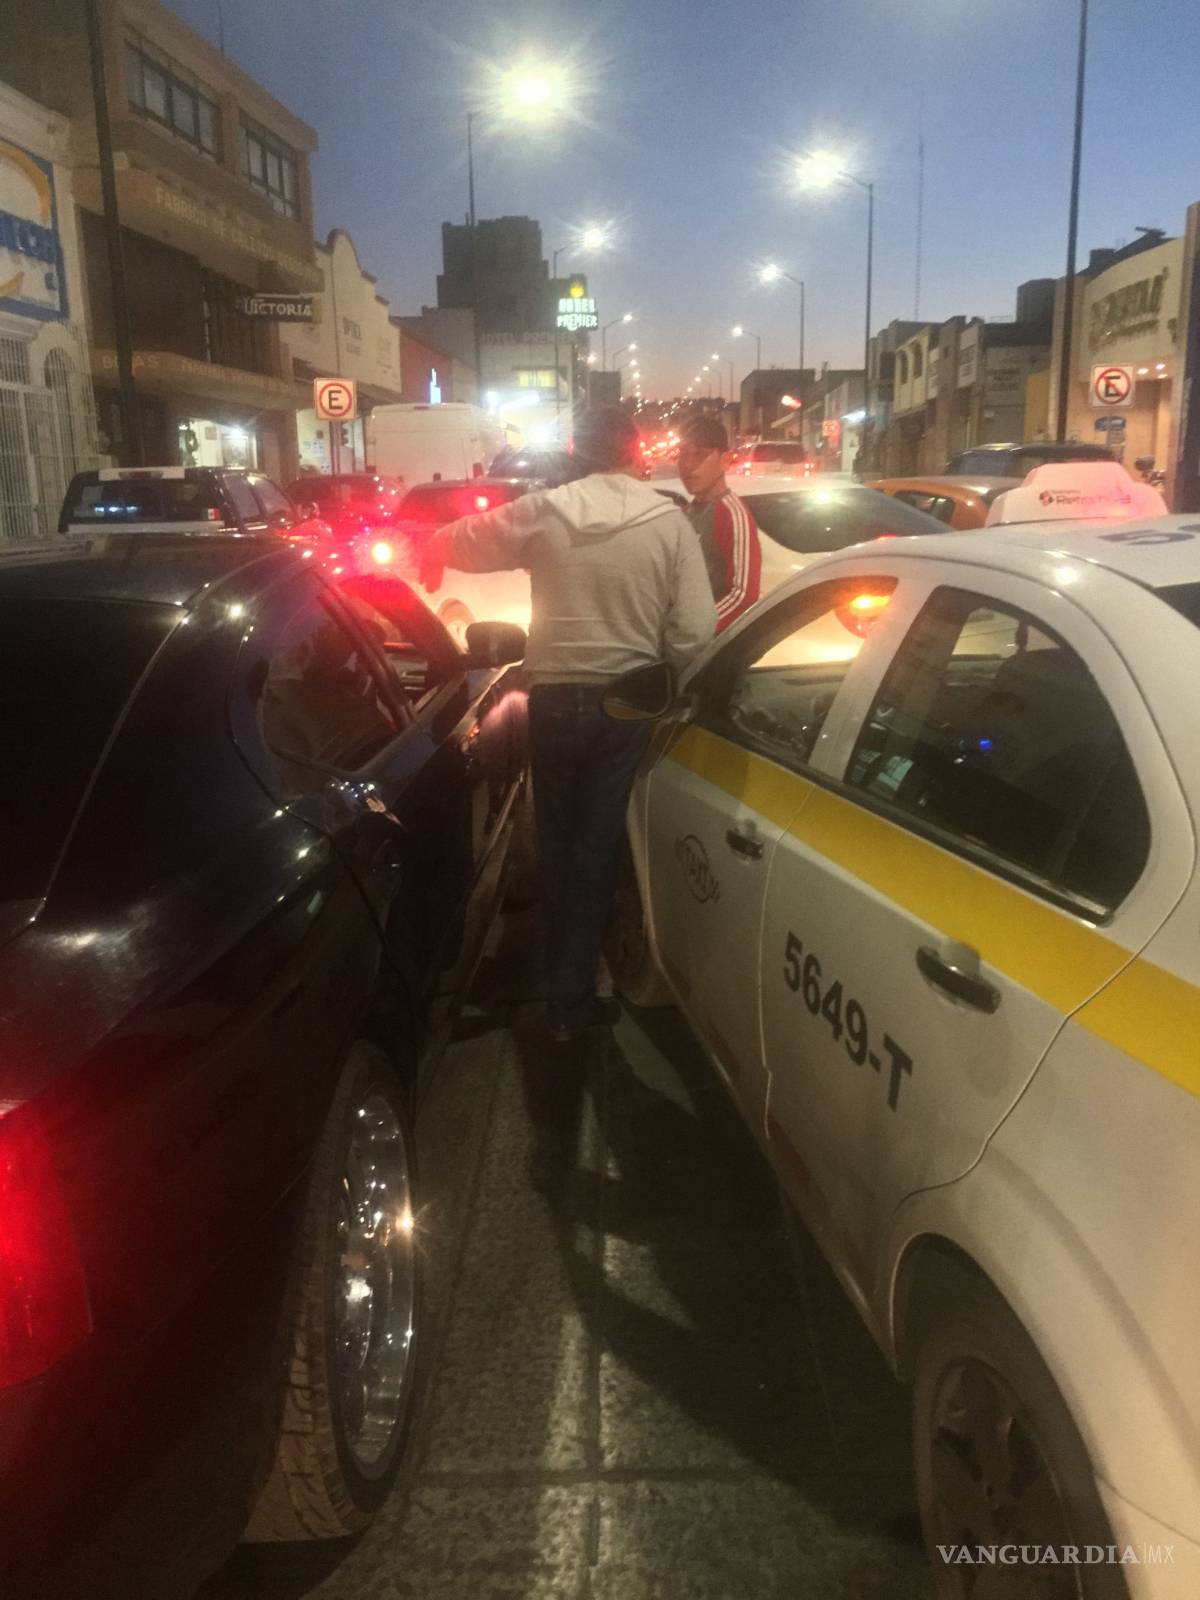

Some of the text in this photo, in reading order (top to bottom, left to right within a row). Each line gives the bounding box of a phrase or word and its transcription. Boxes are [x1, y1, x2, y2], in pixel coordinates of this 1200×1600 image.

[558, 298, 596, 313] HOTEL
[557, 313, 598, 331] PREMIER
[1103, 375, 1122, 398] E
[328, 390, 343, 410] E
[783, 930, 913, 1113] 5649-T
